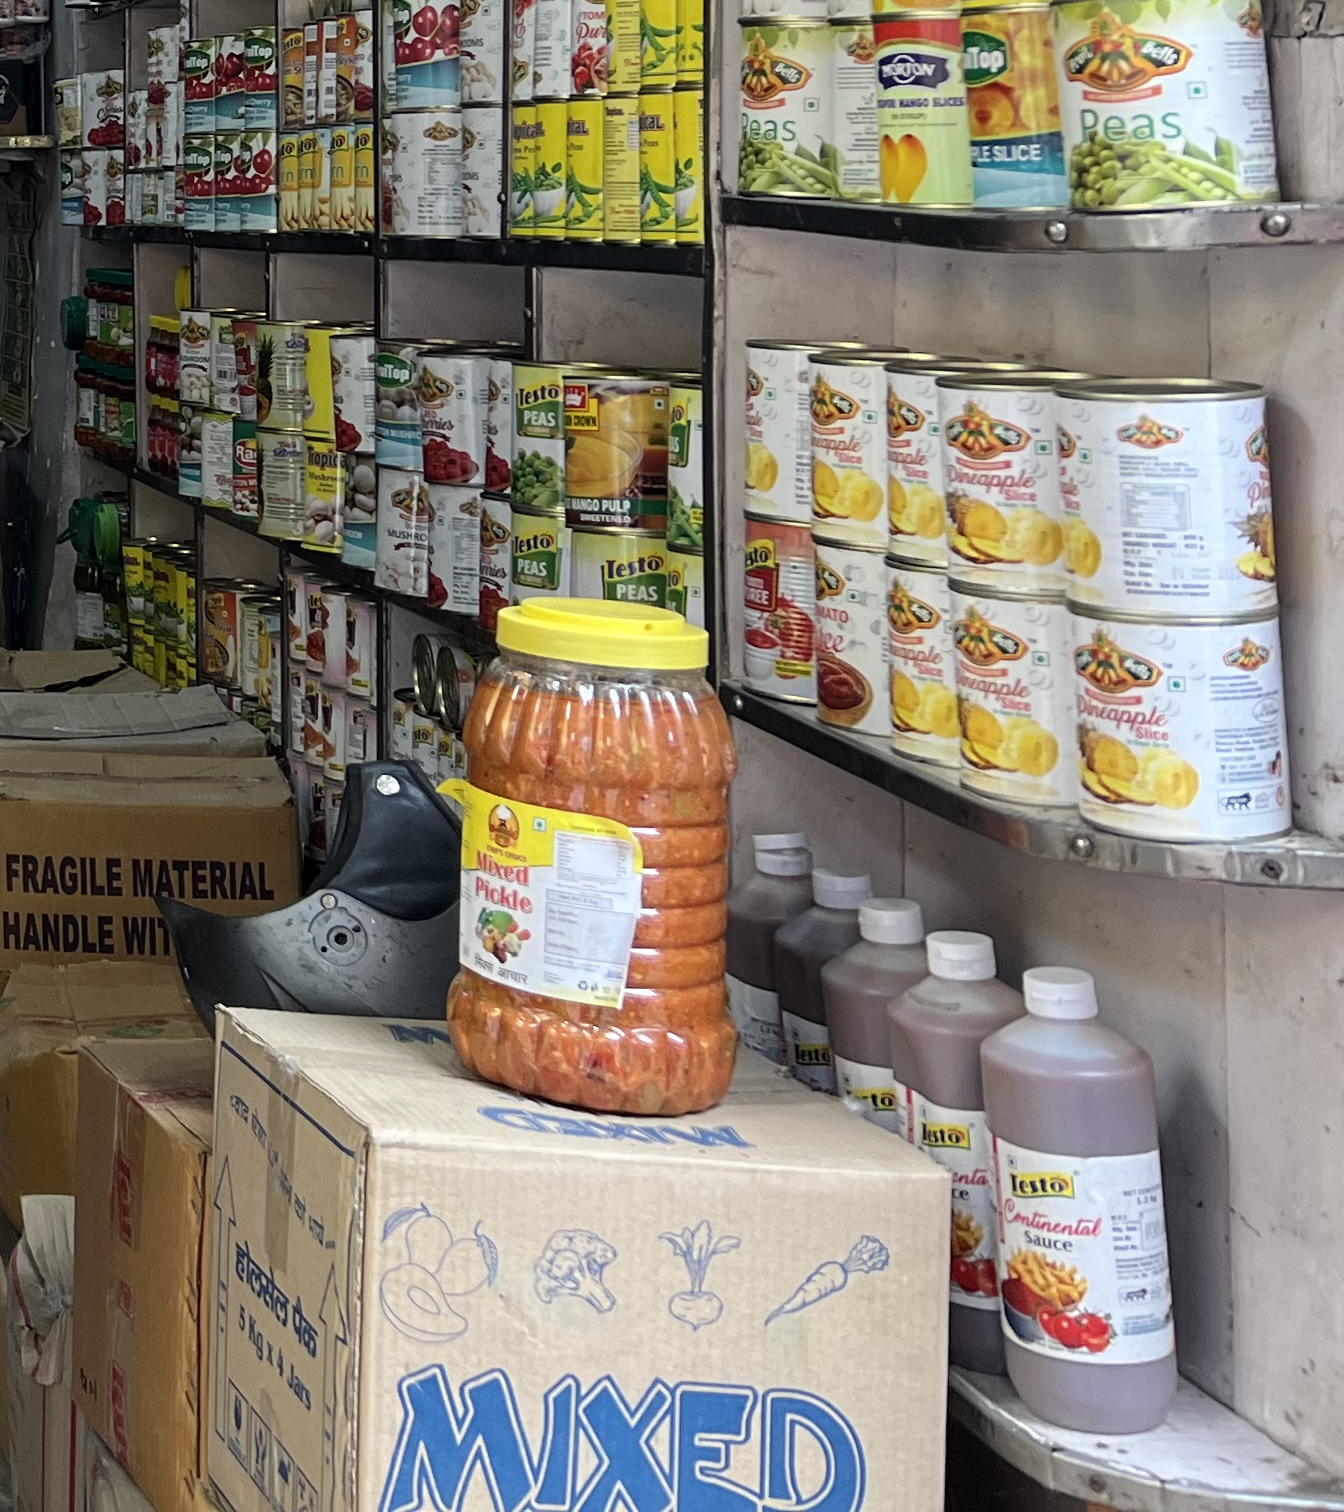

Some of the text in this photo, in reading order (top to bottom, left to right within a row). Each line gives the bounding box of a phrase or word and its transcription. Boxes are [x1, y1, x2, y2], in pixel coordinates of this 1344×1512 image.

[1140, 41, 1180, 66] Bells
[774, 63, 800, 85] Bells
[881, 60, 936, 79] MORTON
[899, 97, 929, 108] MANGO
[1079, 108, 1183, 141] Peas
[993, 144, 1042, 163] SLICE
[519, 385, 560, 407] Testo
[523, 411, 556, 426] PEAS
[602, 499, 631, 513] PULP
[1004, 489, 1037, 502] Slice
[514, 533, 553, 554] Testo
[517, 559, 547, 576] PEAS
[605, 555, 663, 579] Testo
[616, 583, 658, 602] PEAS
[1001, 699, 1032, 712] Slice
[1135, 726, 1169, 740] Slice
[6, 854, 123, 896] FRAGILE
[132, 858, 275, 901] MATERIAL
[476, 850, 529, 886] Mixed
[475, 876, 533, 914] Pickle
[3, 911, 115, 954] HANDLE
[922, 1122, 966, 1146] Testo
[1011, 1173, 1068, 1195] Testo
[1003, 1199, 1102, 1237] Continental
[1024, 1230, 1073, 1252] Sauce
[249, 1319, 312, 1411] Kg Jars
[378, 1364, 867, 1512] MIXED
